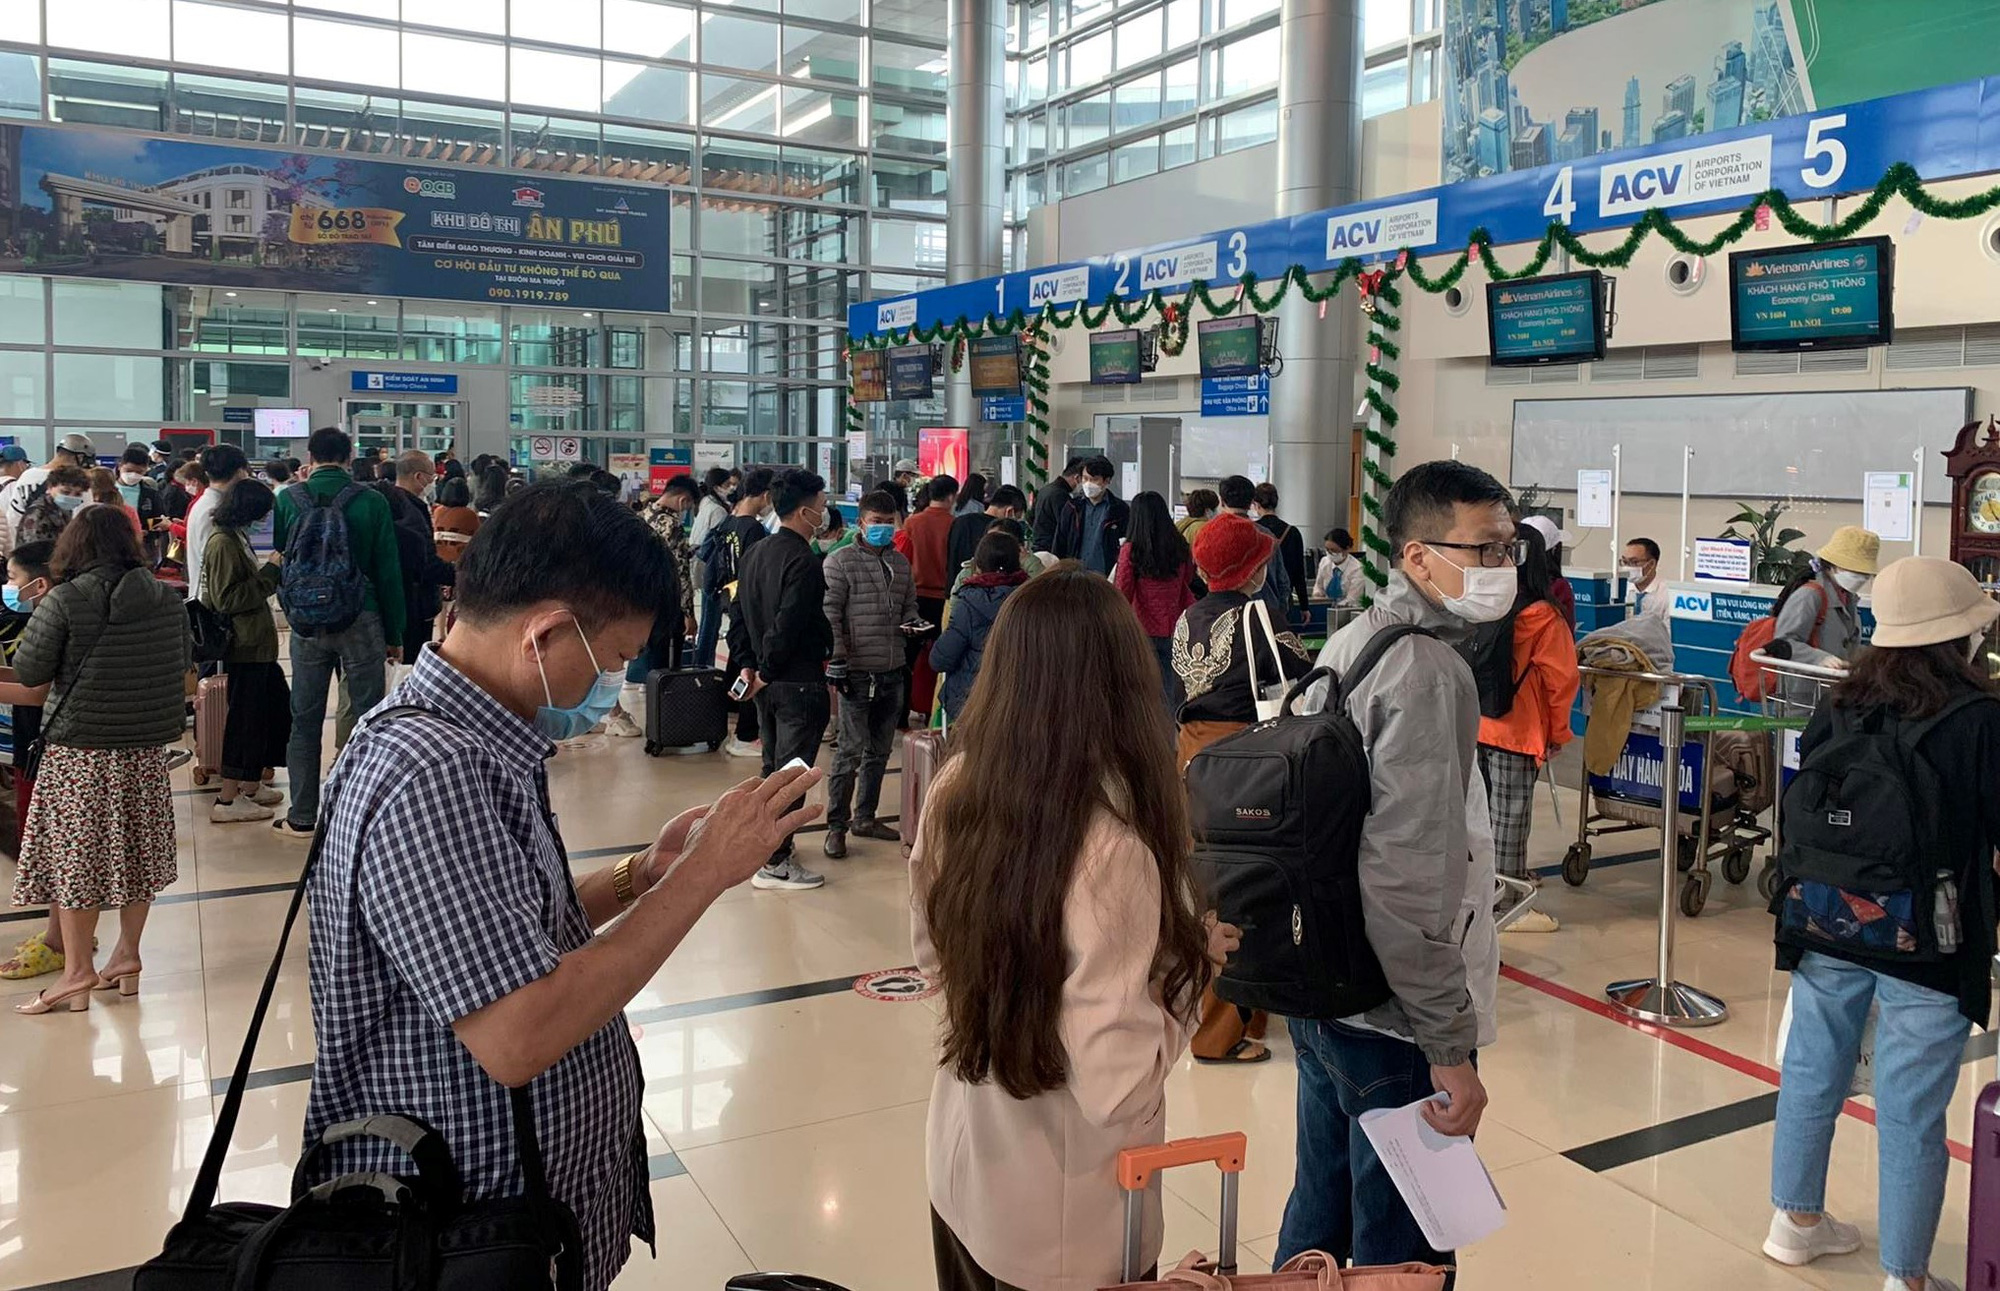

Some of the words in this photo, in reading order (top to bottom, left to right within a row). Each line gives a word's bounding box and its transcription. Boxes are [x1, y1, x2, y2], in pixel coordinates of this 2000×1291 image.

[1695, 152, 1742, 169] AIRPORTS
[1801, 113, 1847, 188] 5
[1694, 160, 1763, 180] CORPORATION
[420, 179, 455, 195] OCB
[1608, 164, 1682, 205] ACV
[1694, 181, 1706, 191] OF
[1709, 173, 1750, 189] VIETNAM
[1543, 166, 1576, 226] 4
[317, 210, 366, 230] 668
[433, 212, 466, 229] KHU
[468, 211, 491, 231] ĐÔ
[494, 216, 520, 235] THỊ
[526, 211, 562, 241] ÂN
[569, 217, 621, 246] PHÚ
[1332, 219, 1381, 250] ACV
[457, 244, 479, 253] GIAO
[518, 248, 538, 256] KINH
[539, 250, 567, 259] DOANH
[572, 252, 585, 260] VUI
[1227, 231, 1248, 278] 3
[455, 260, 476, 272] HỘI
[504, 262, 518, 273] TƯ
[520, 264, 558, 276] KHÔNG
[600, 270, 621, 280] QUA
[1114, 256, 1130, 296] 2
[1144, 257, 1178, 282] ACV
[488, 287, 570, 302] 090.1919.789
[996, 278, 1004, 314] 1
[1033, 279, 1059, 300] ACV
[1771, 295, 1809, 306] Economy
[1811, 292, 1835, 302] Class
[880, 309, 896, 324] ACV
[1675, 596, 1710, 612] ACV
[1728, 598, 1739, 608] VUI
[1740, 599, 1758, 611] LÒNG
[1236, 807, 1271, 816] SAKOS
